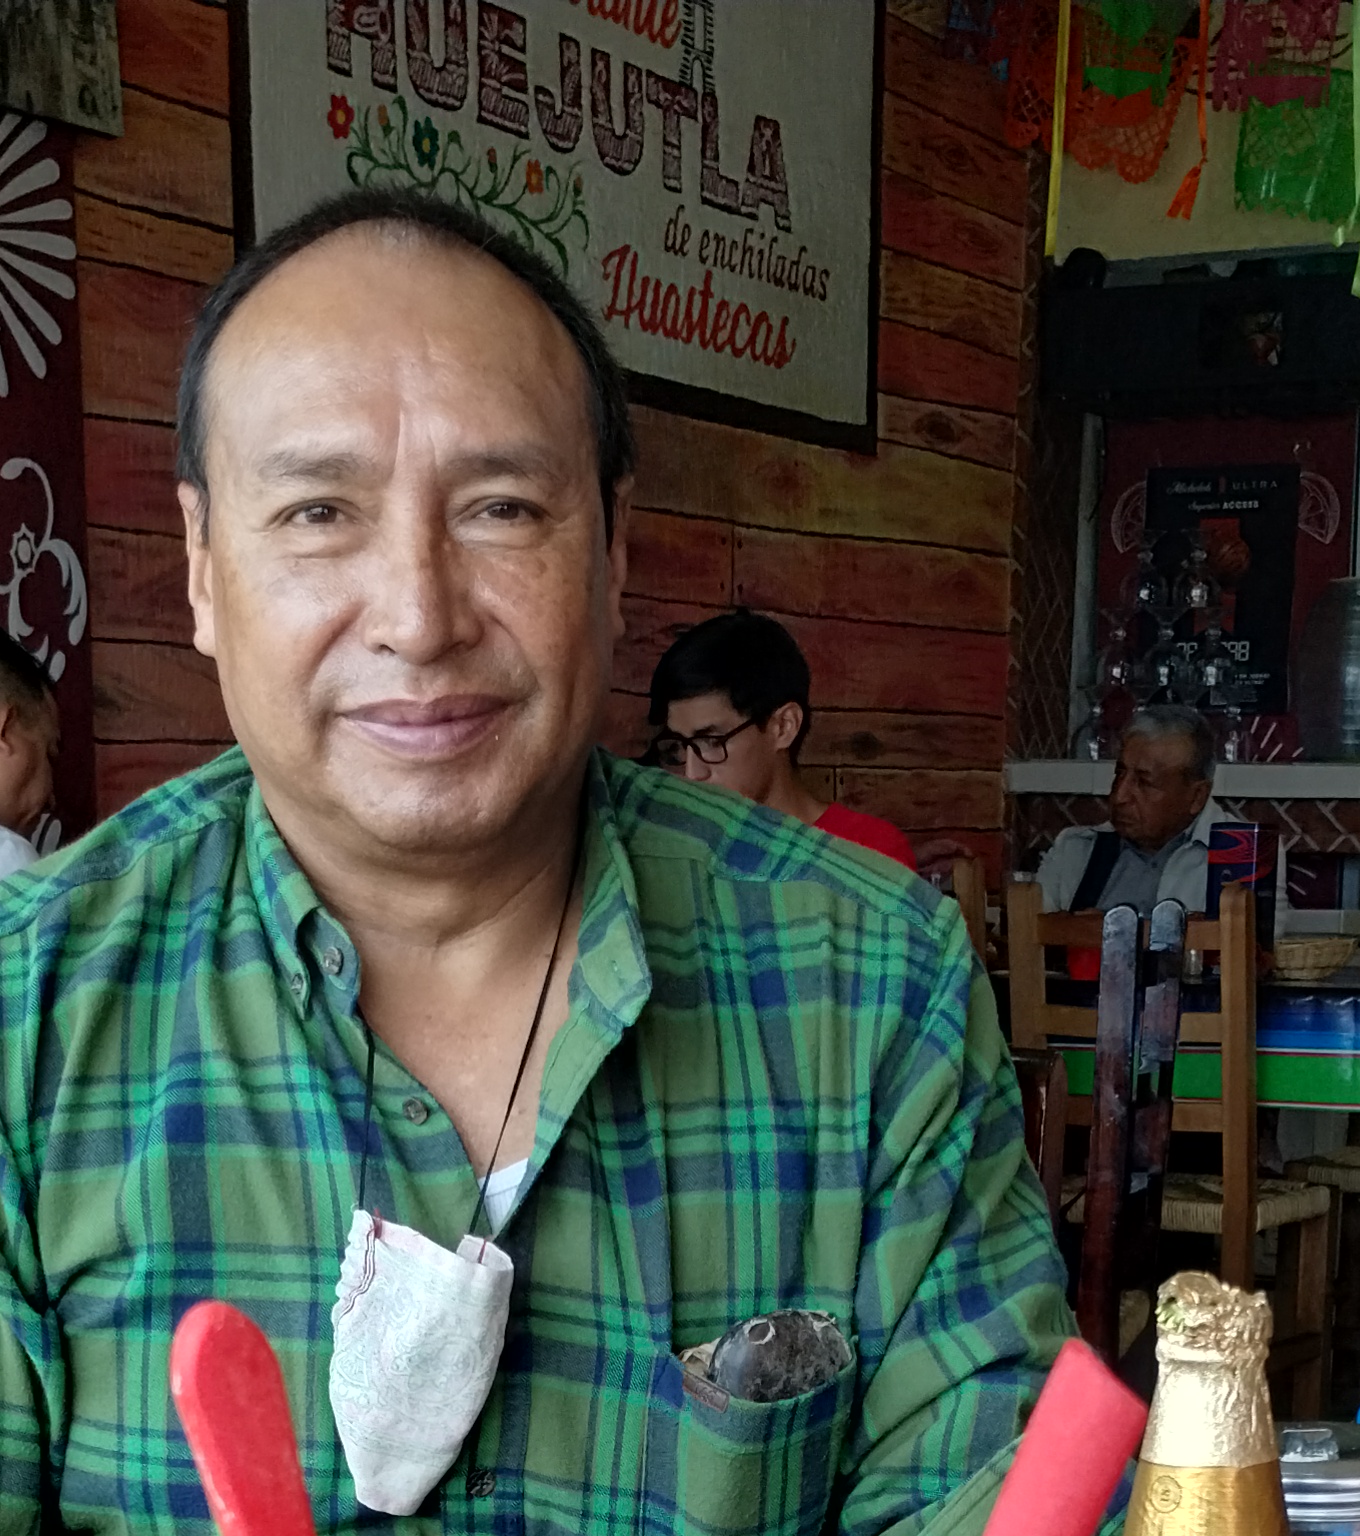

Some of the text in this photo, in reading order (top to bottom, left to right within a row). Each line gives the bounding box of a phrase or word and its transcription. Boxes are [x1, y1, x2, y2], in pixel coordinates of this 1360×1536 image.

[663, 204, 831, 302] de enchiladas
[601, 243, 797, 369] Huastecas
[1232, 480, 1279, 491] ULTRA
